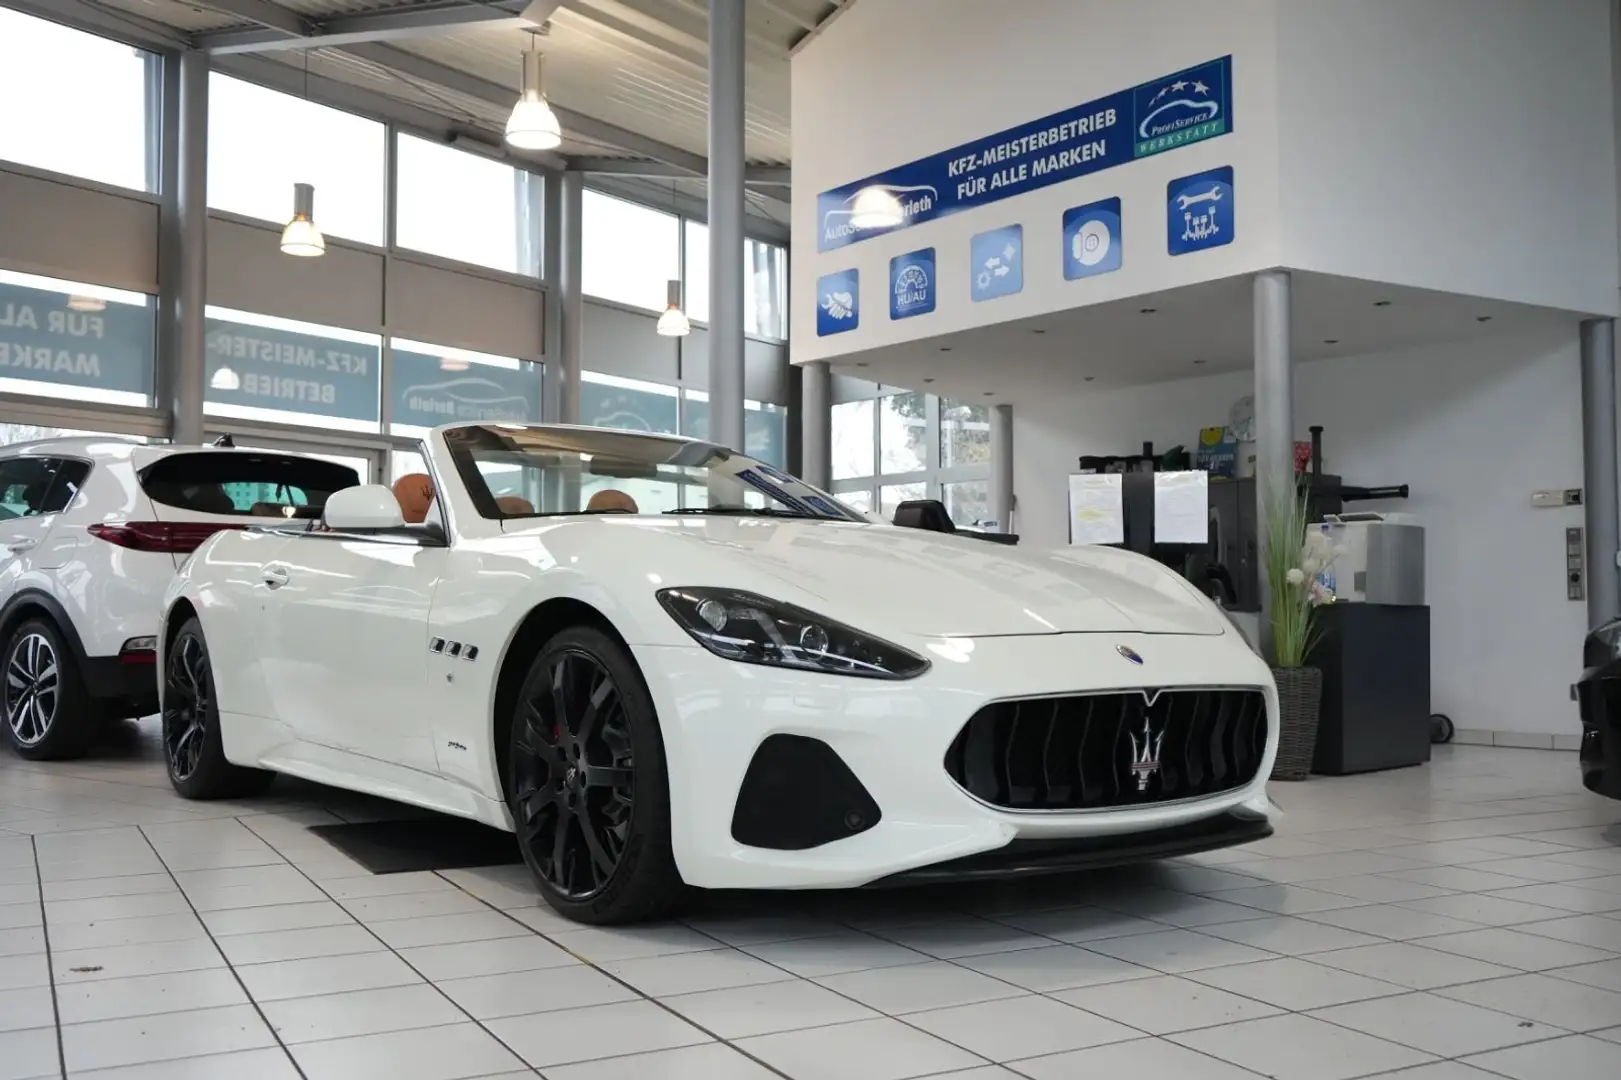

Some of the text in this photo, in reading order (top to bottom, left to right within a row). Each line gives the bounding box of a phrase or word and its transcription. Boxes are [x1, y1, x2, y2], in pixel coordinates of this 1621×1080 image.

[948, 108, 1117, 177] KFZ-MEISTERBETRIEB
[1140, 122, 1219, 153] WERKSTATT
[957, 139, 1106, 200] FÜR ALLE MARKEN
